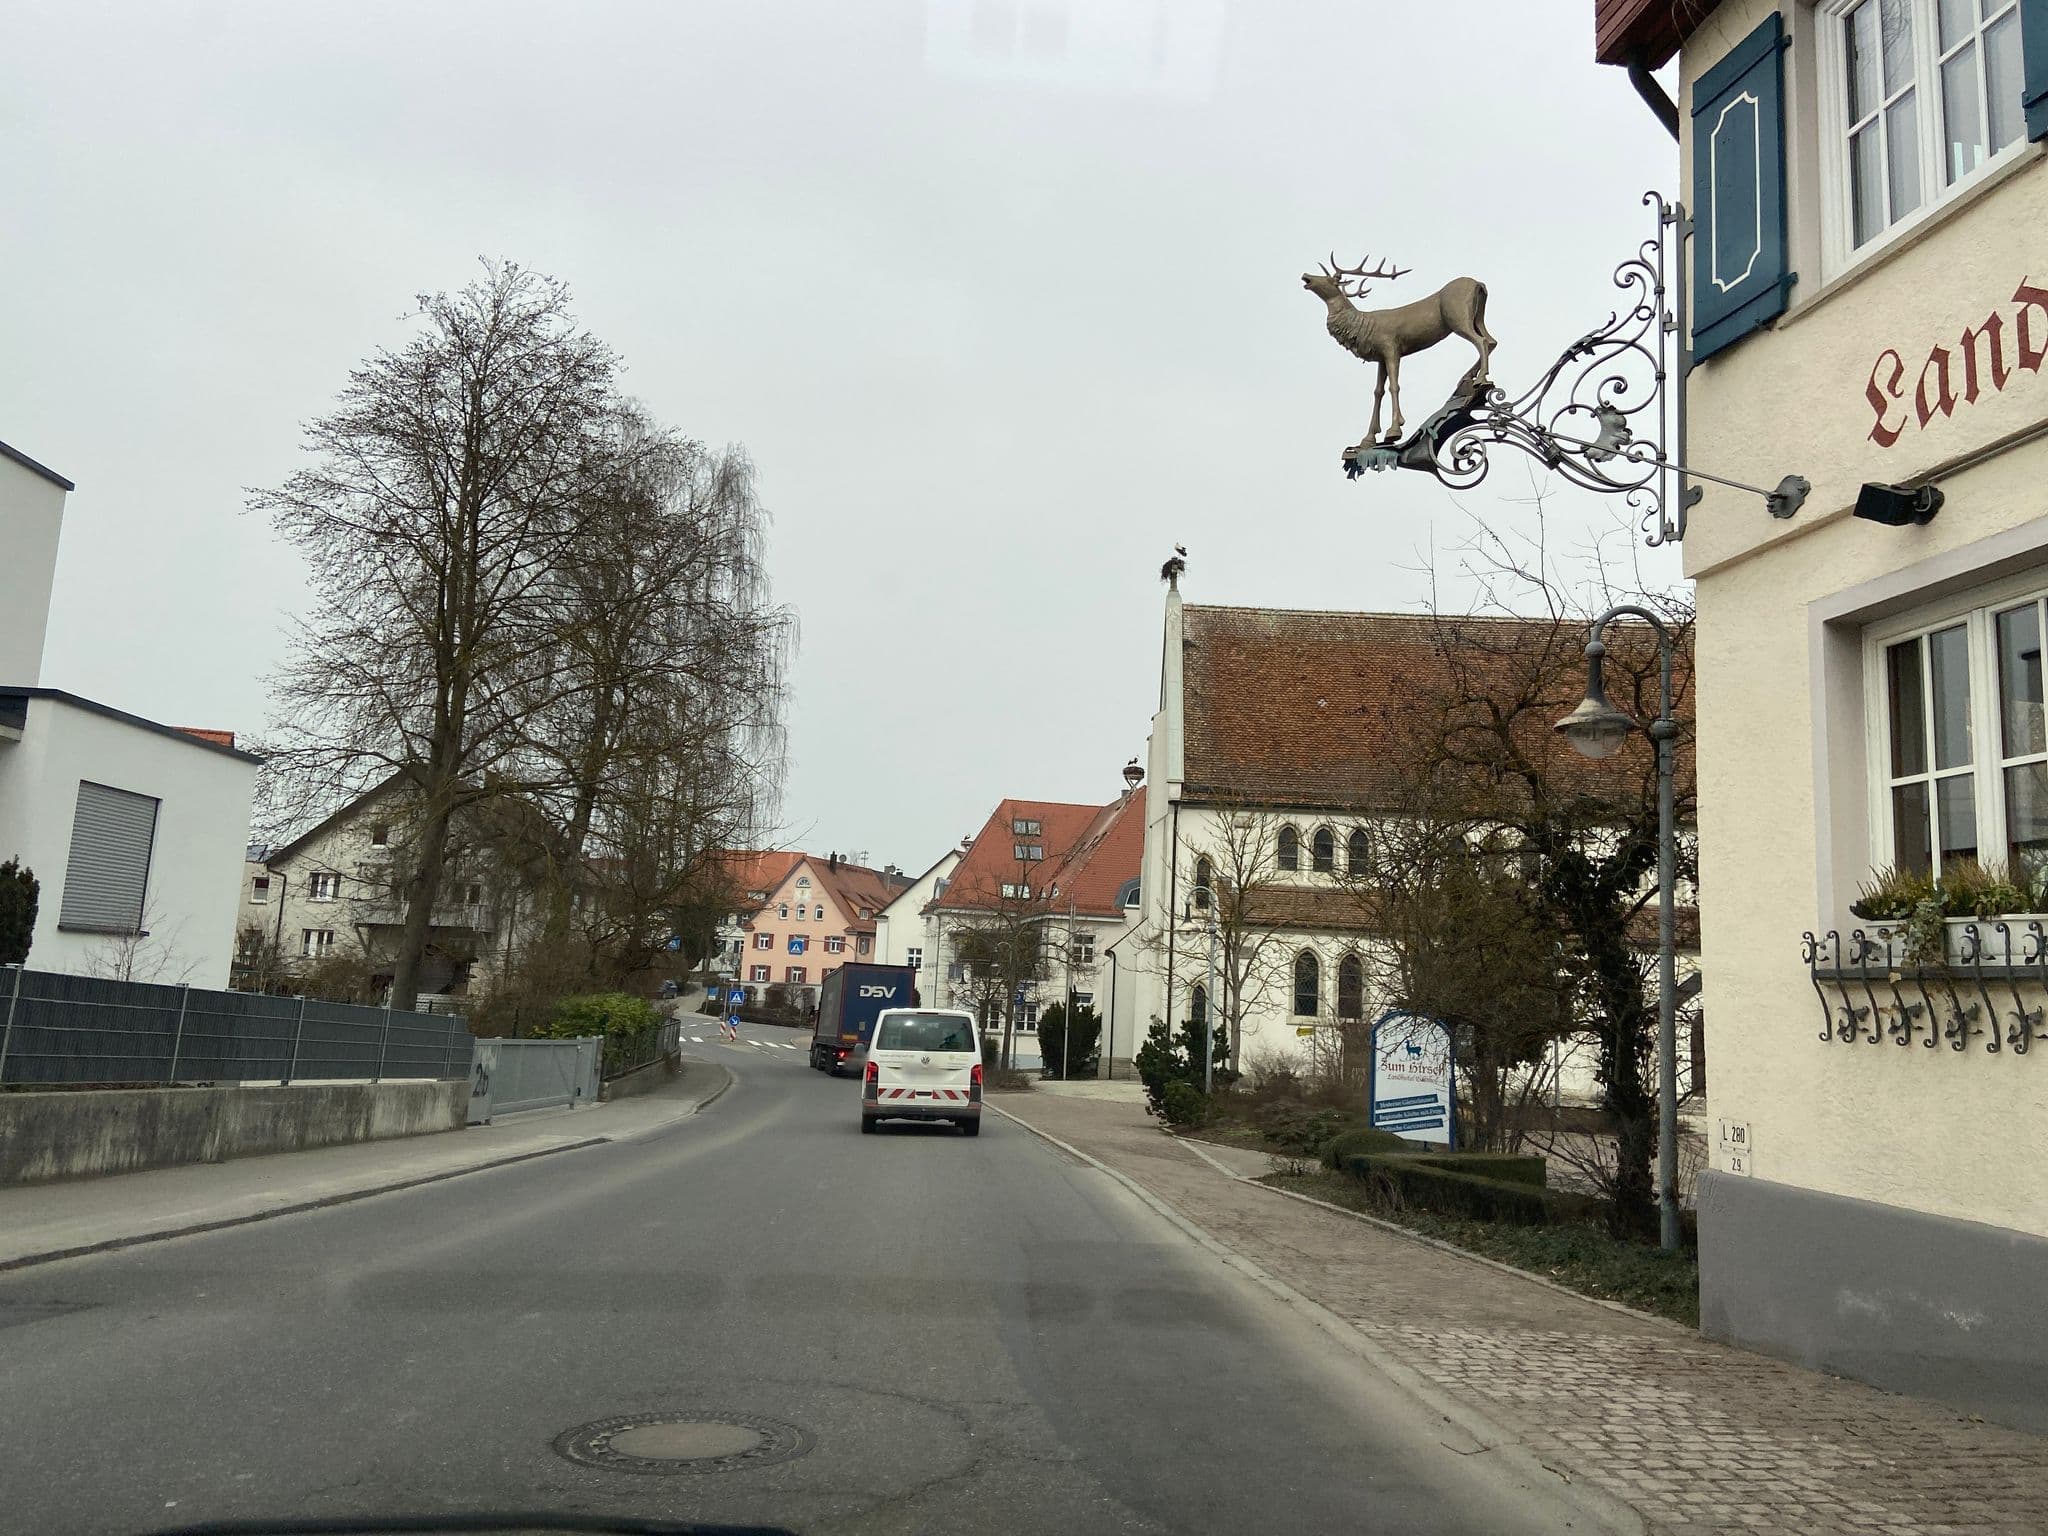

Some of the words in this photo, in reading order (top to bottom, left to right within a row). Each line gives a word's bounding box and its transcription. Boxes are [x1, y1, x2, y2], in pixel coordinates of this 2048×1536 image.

[859, 985, 897, 998] DSV
[1381, 1058, 1405, 1072] Zum
[1409, 1061, 1445, 1075] Hirsch
[1722, 1124, 1728, 1141] L
[1731, 1126, 1745, 1143] 280
[1732, 1157, 1742, 1171] 29
